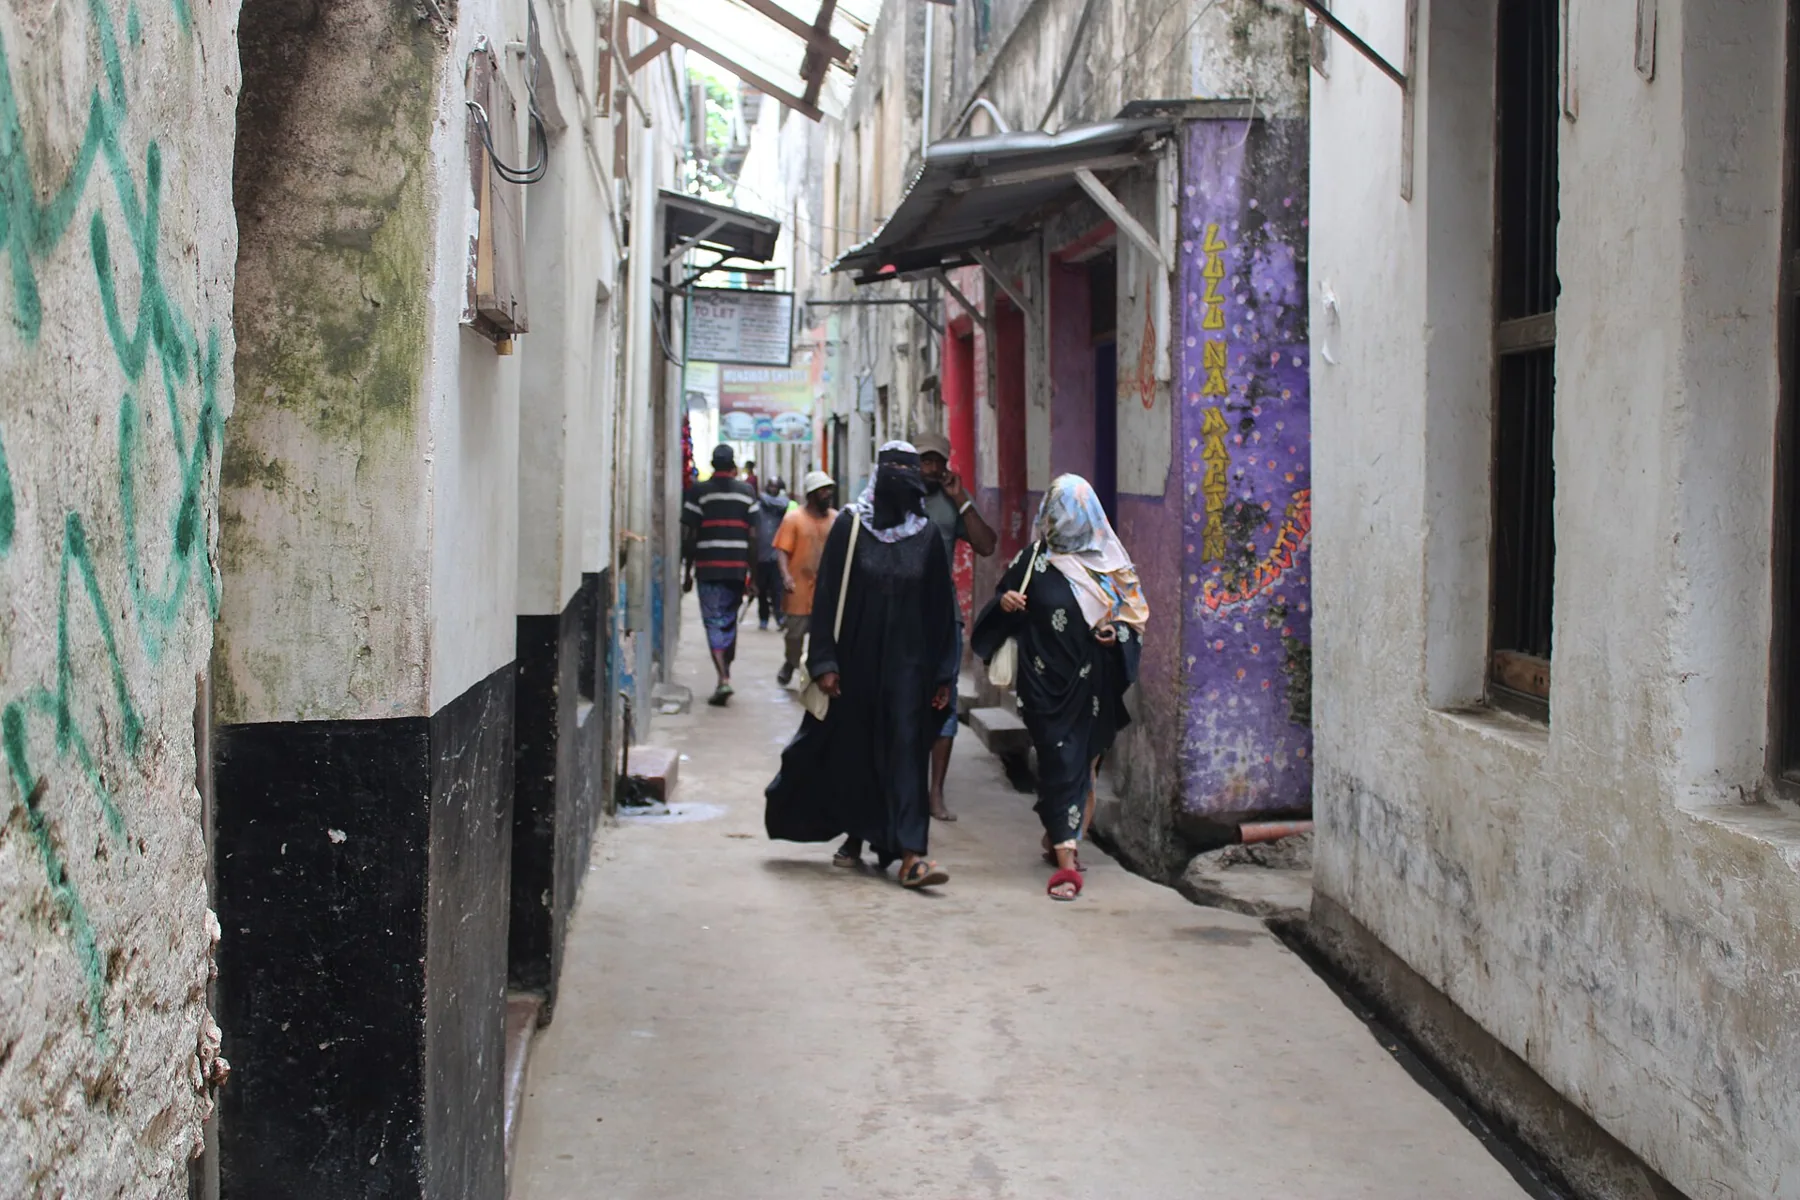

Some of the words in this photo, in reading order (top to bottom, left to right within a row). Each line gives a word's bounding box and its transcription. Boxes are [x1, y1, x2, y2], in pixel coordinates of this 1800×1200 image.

[694, 305, 710, 317] TO
[712, 307, 736, 319] LET
[1202, 338, 1229, 397] NA
